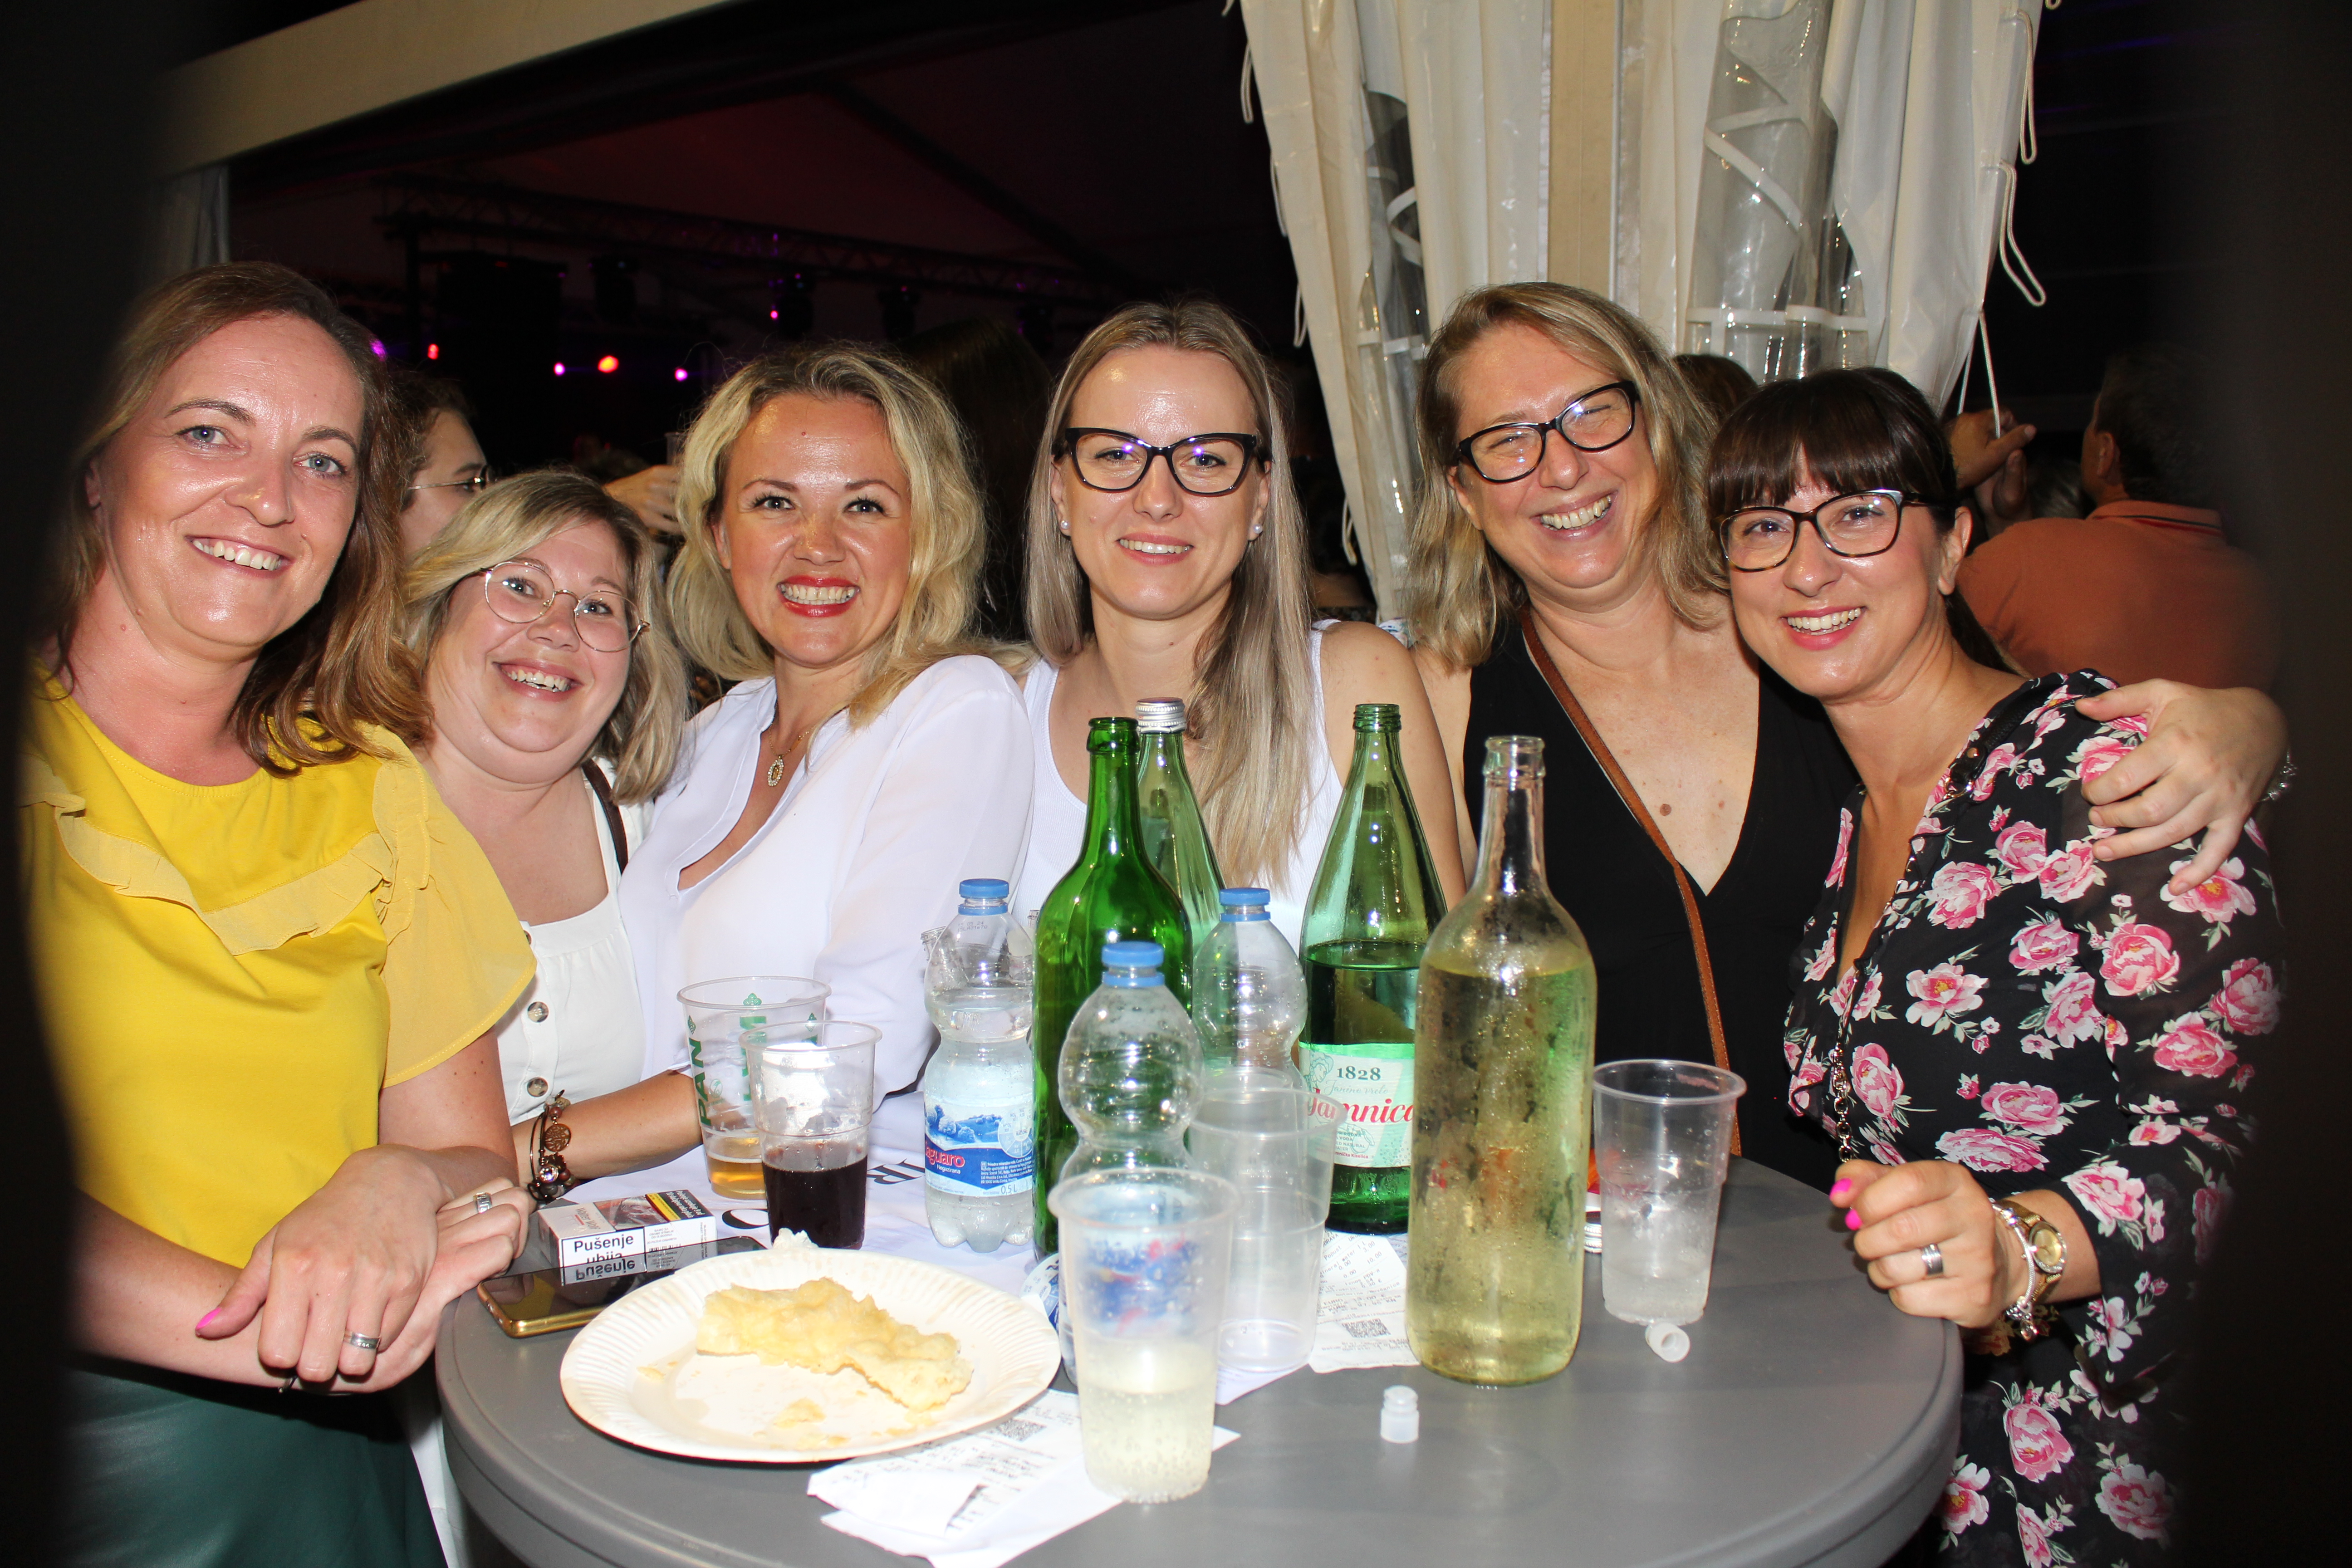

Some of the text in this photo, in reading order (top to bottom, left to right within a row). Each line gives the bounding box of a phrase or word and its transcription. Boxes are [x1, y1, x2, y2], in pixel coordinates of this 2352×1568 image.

[689, 1037, 711, 1126] PAN
[1337, 1066, 1381, 1081] 1828
[926, 1143, 965, 1168] aguaro
[937, 1164, 961, 1175] Negazirana
[574, 1234, 634, 1253] Pušenje
